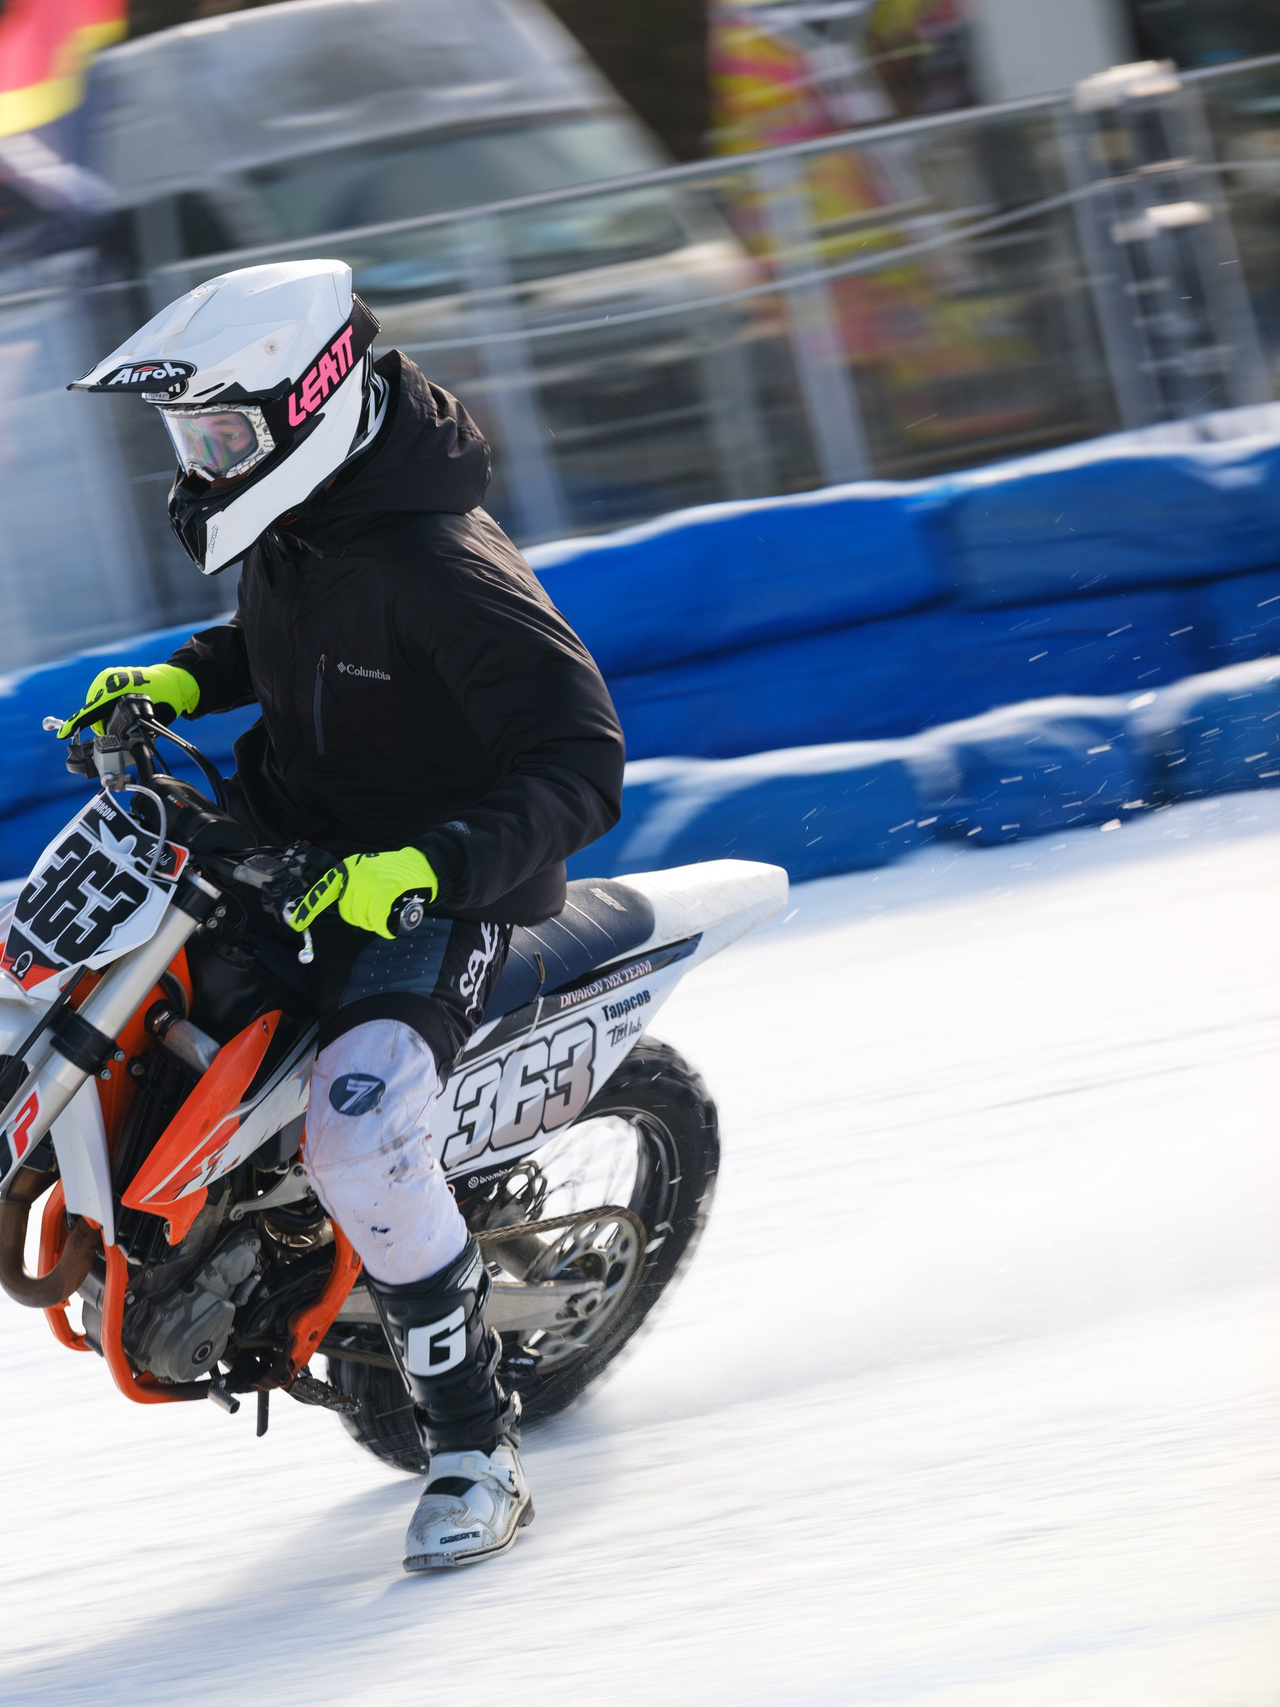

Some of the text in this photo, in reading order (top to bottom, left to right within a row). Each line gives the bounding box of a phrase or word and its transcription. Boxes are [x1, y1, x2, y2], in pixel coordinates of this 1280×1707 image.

[107, 362, 187, 386] Airoh
[288, 325, 353, 427] LEATT
[346, 664, 391, 681] Columbia
[14, 829, 152, 966] 363
[621, 960, 652, 983] TEAM
[440, 1018, 597, 1171] 363
[408, 1305, 466, 1377] G
